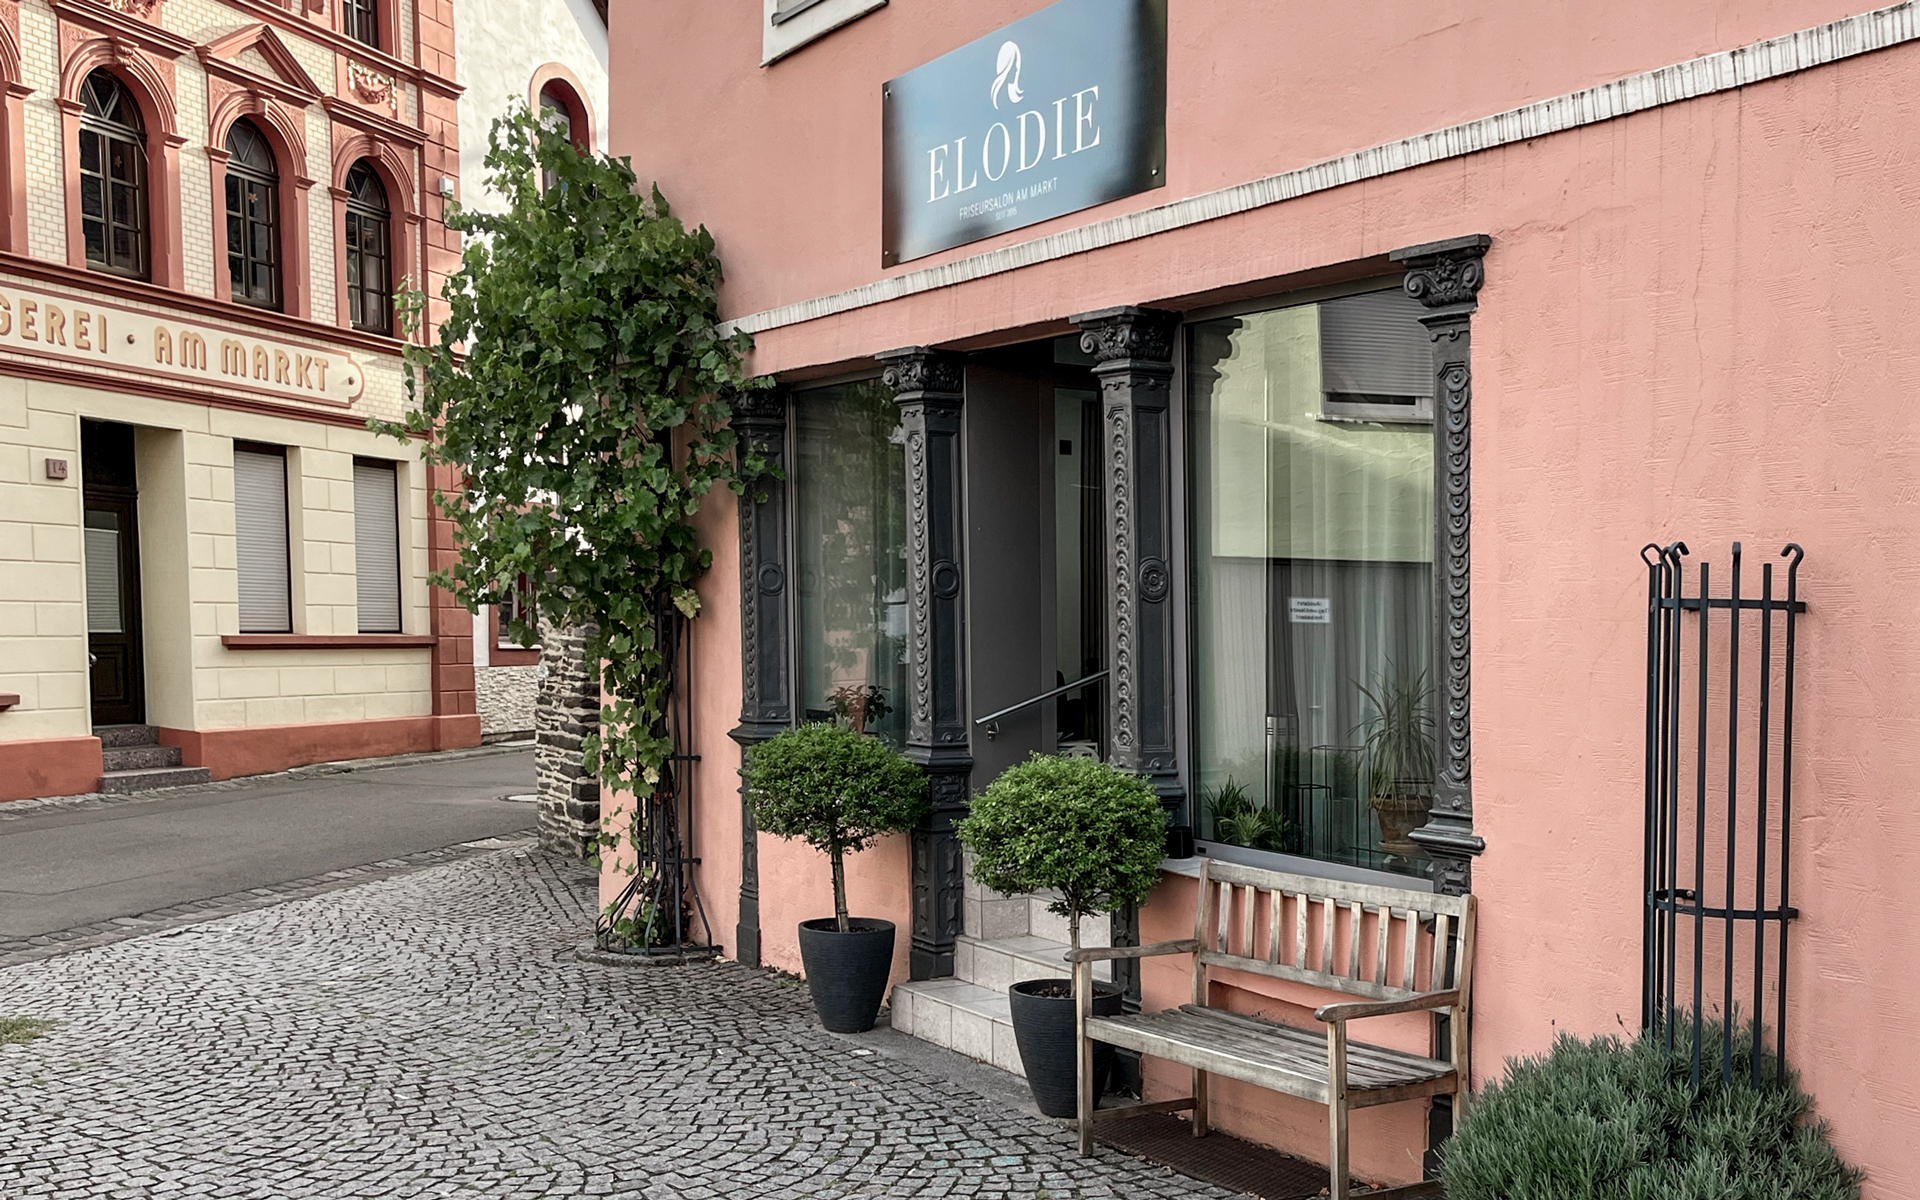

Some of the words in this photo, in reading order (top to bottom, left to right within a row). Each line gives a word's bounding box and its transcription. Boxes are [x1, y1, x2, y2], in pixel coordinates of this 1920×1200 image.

[926, 85, 1100, 203] ELODIE
[959, 192, 1014, 220] FRISEURSALON
[1015, 187, 1028, 202] AM
[1030, 177, 1058, 198] MARKT
[154, 325, 207, 371] AM
[220, 338, 329, 392] MARKT
[52, 462, 66, 475] 14
